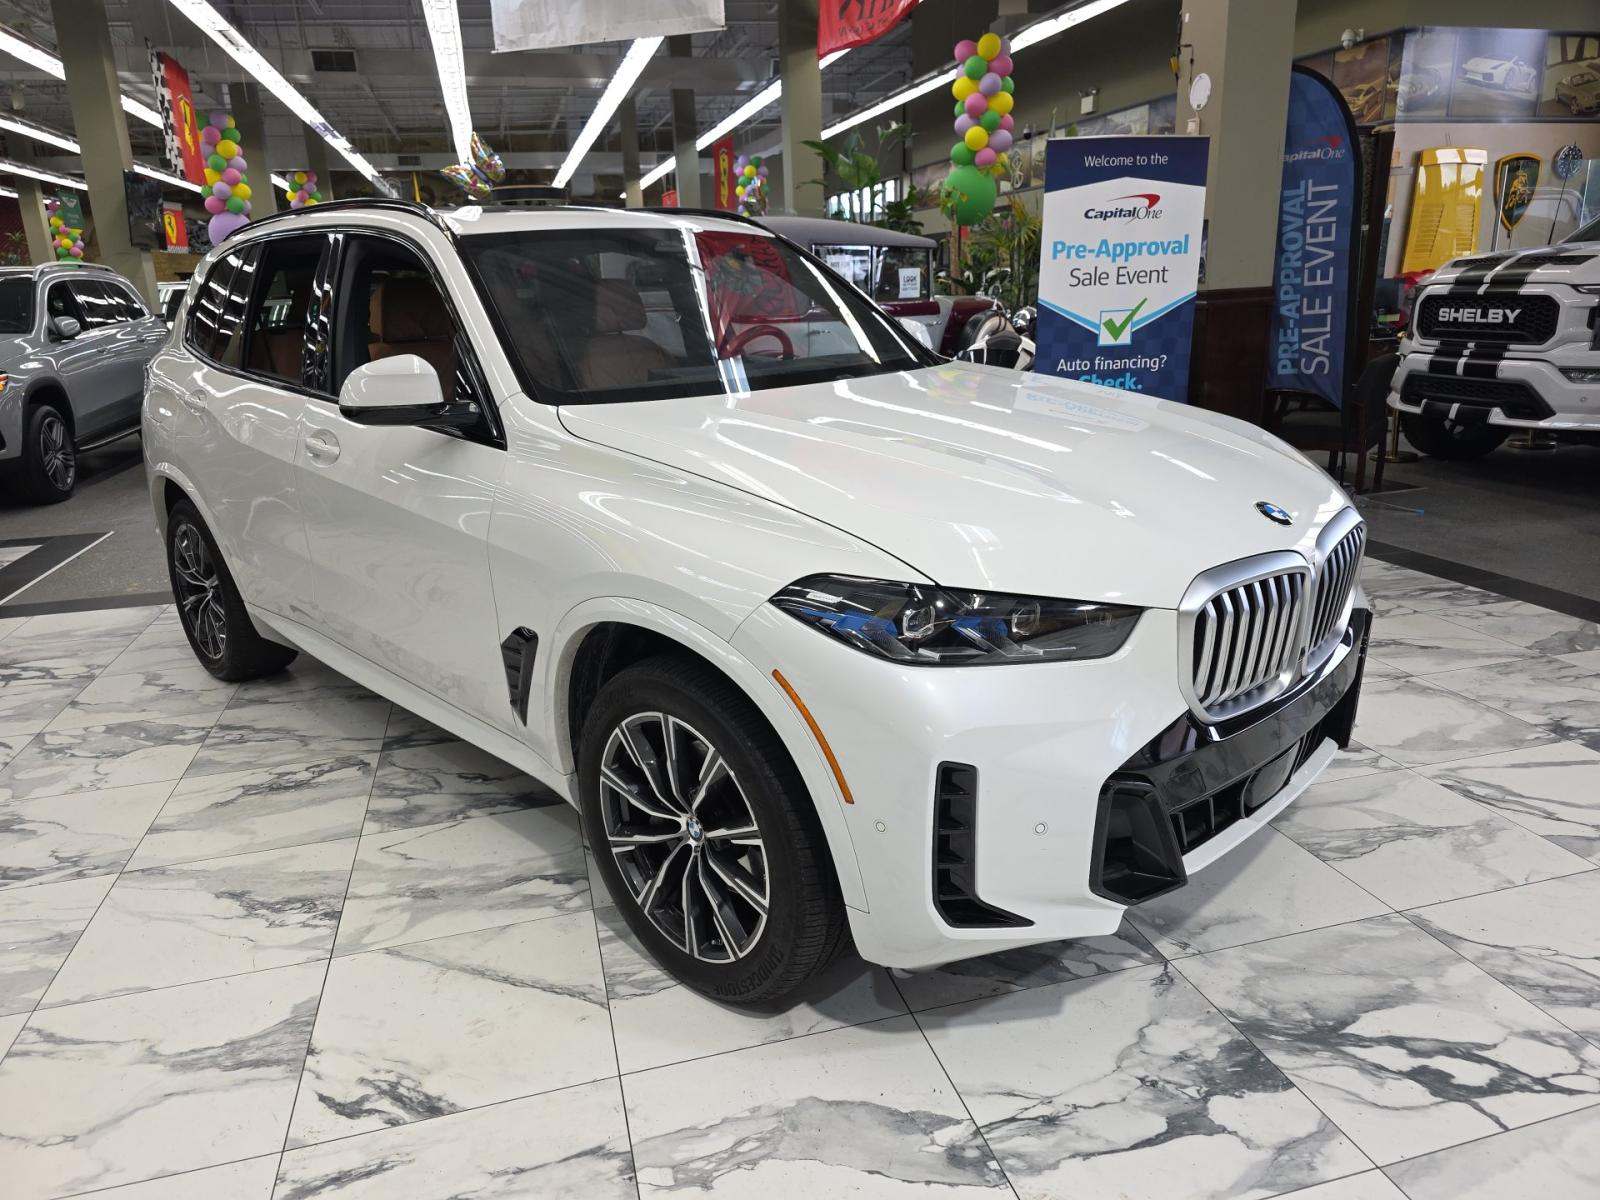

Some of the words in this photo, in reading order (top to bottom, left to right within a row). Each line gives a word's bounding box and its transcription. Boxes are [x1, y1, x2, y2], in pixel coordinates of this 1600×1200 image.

[1084, 154, 1133, 167] Welcome
[1136, 155, 1148, 165] to
[1151, 153, 1169, 165] the
[1280, 147, 1345, 163] apitalOne
[1303, 178, 1339, 287] EVENT
[1052, 234, 1190, 263] Pre-Approval
[1069, 266, 1110, 287] Sale
[1116, 266, 1169, 285] Event
[1277, 179, 1306, 375] PRE-APPROVAL
[1438, 308, 1522, 324] SHELBY
[1300, 295, 1332, 375] SALE
[1057, 358, 1091, 372] Auto
[1095, 354, 1168, 372] financing?
